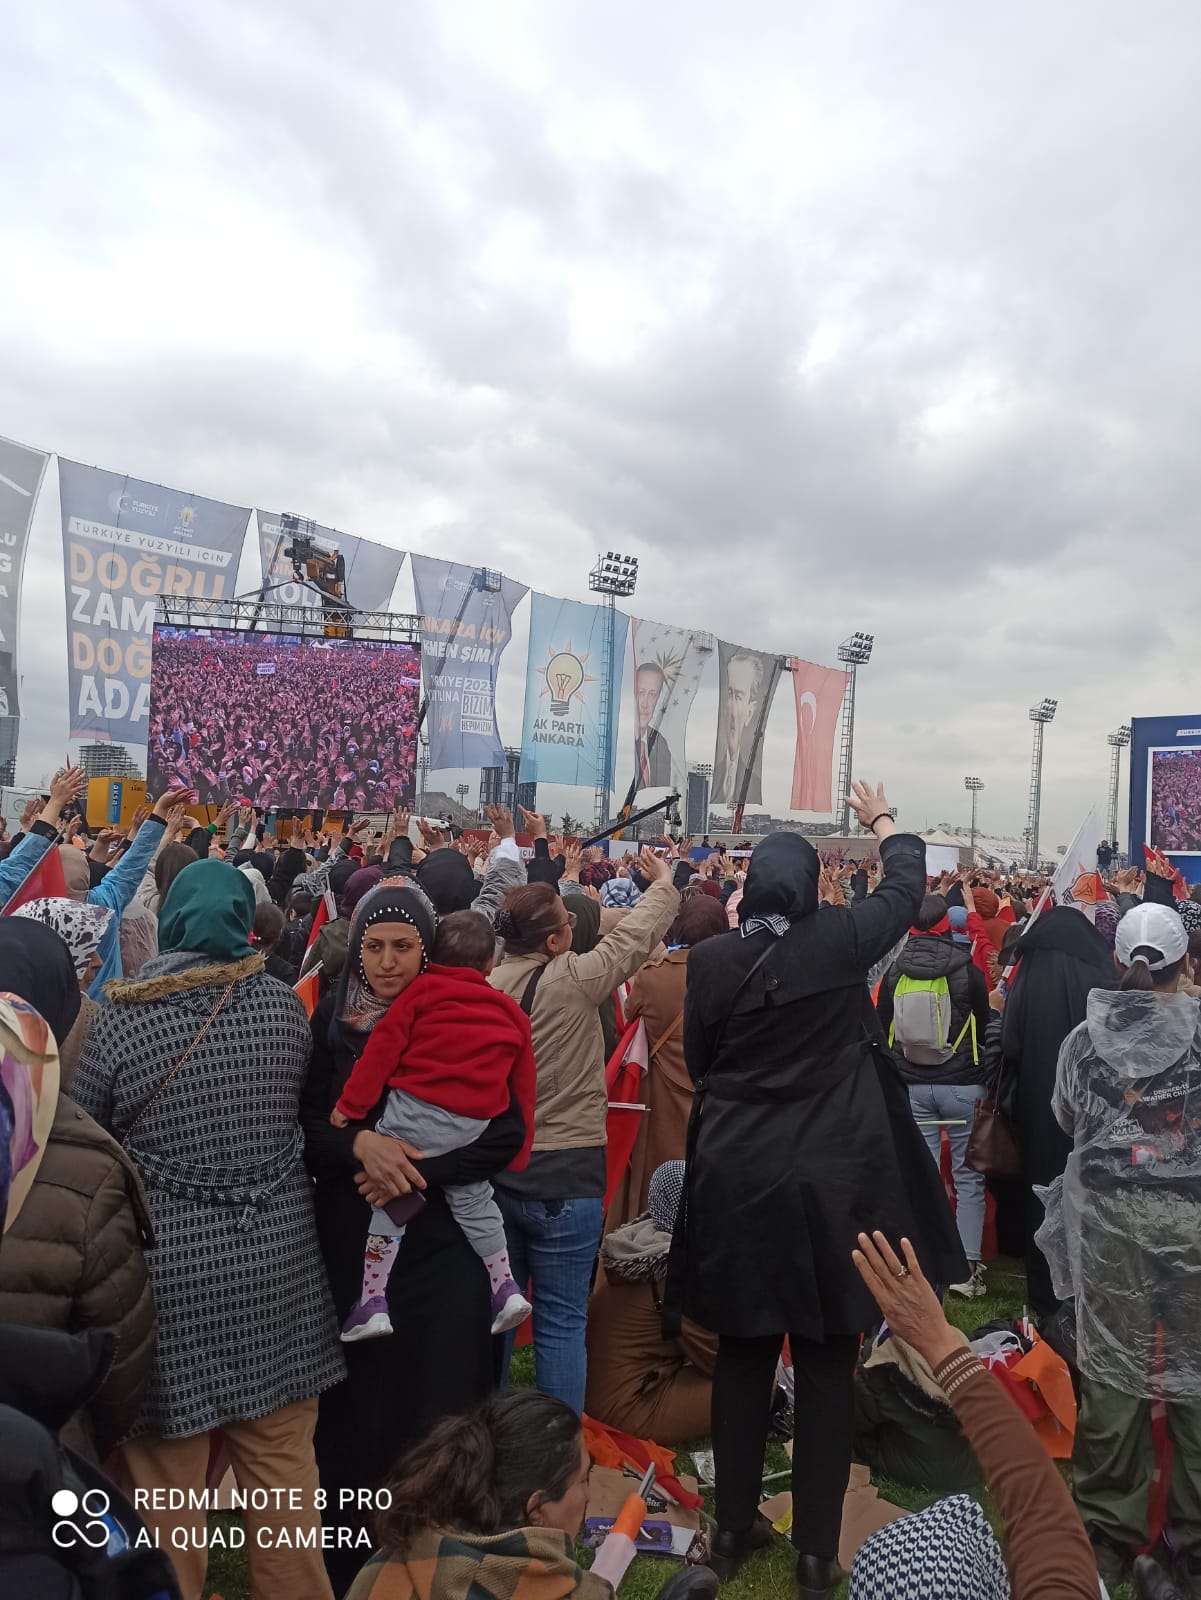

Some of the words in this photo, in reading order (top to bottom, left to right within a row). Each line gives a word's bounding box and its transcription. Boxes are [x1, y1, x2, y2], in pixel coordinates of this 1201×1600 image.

[73, 631, 151, 679] DOĞ
[78, 675, 150, 723] ADA
[531, 732, 584, 748] ANKARA
[533, 718, 548, 730] AK
